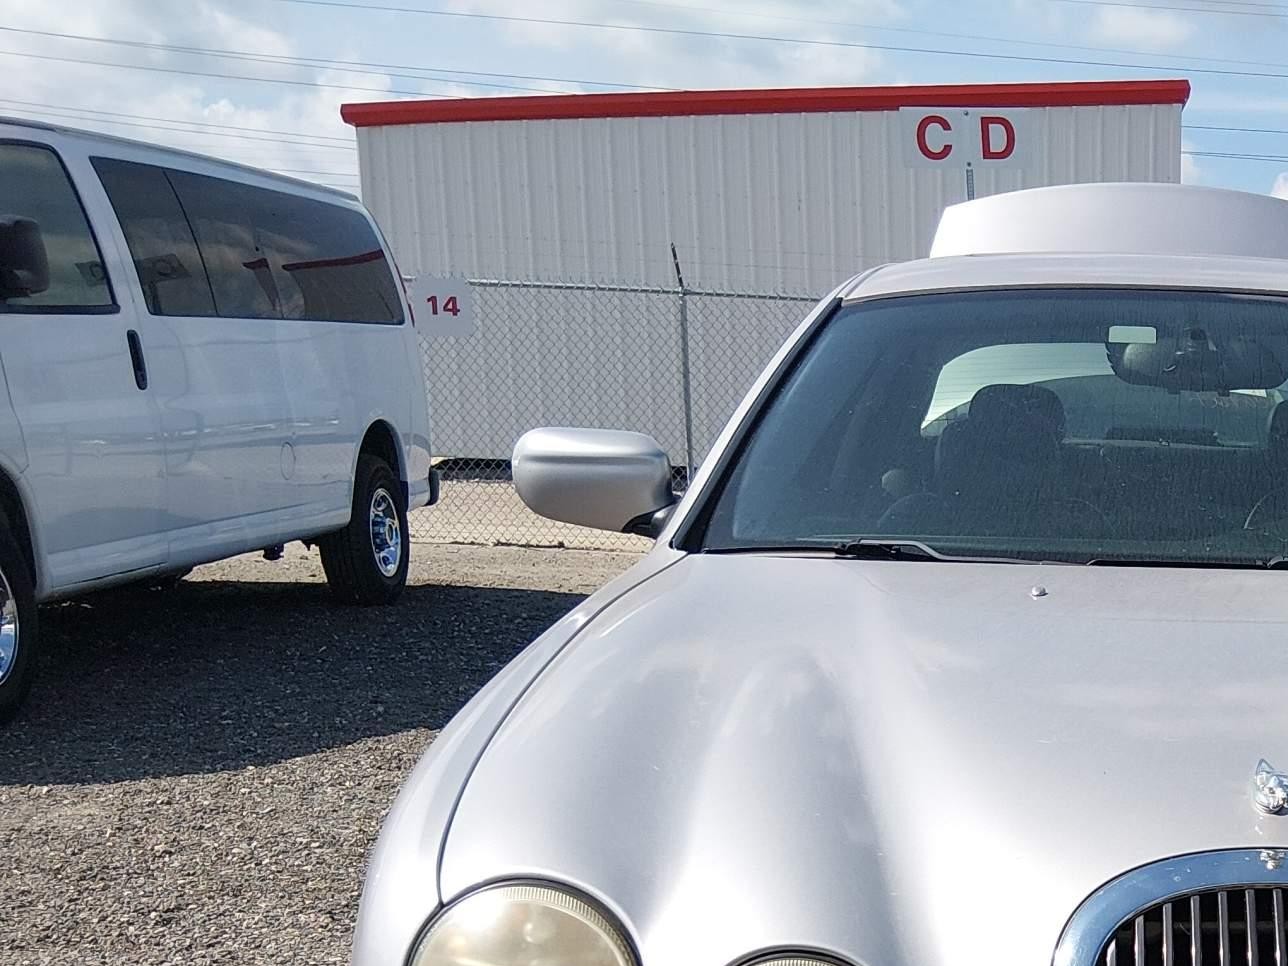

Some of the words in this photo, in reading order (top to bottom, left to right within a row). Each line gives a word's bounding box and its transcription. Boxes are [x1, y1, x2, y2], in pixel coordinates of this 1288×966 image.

[916, 115, 953, 161] C
[980, 116, 1016, 160] D
[427, 295, 461, 316] 14
